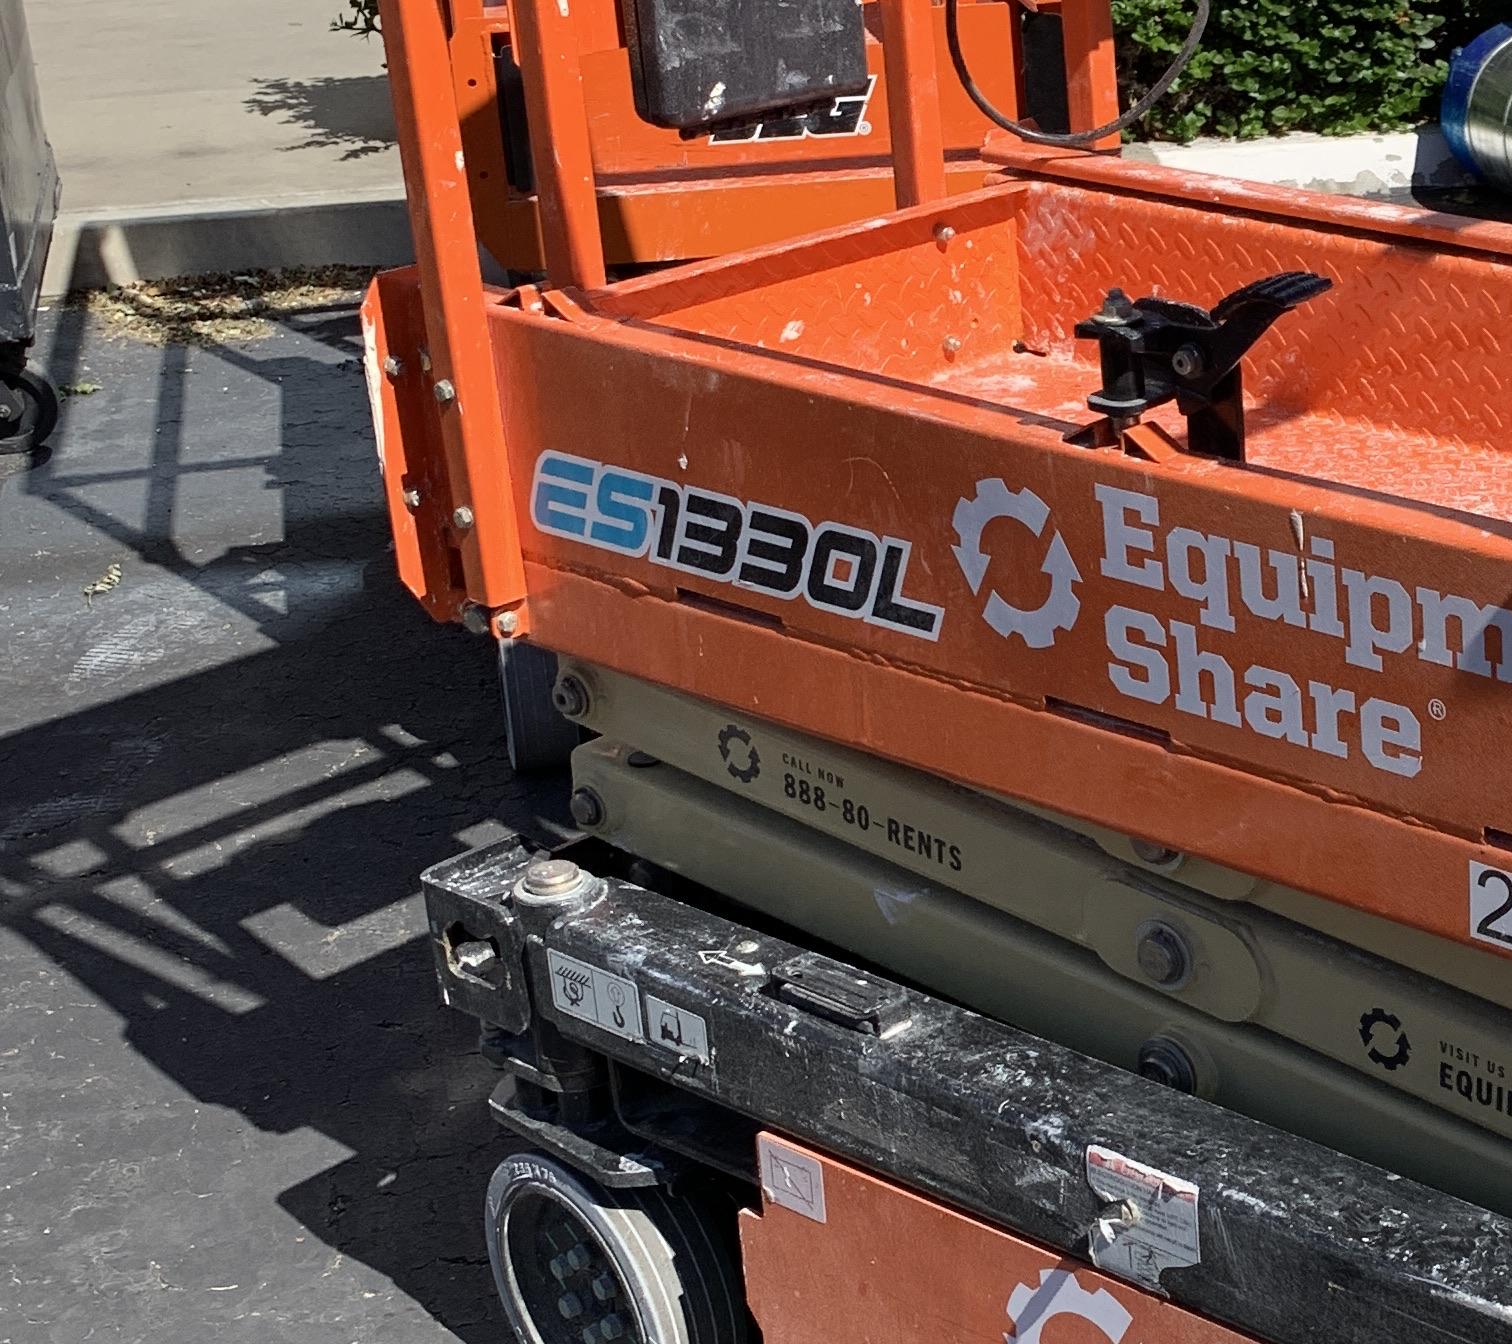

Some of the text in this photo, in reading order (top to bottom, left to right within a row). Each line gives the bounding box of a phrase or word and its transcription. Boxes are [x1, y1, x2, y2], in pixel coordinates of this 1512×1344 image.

[533, 451, 943, 640] ES1330L
[1104, 604, 1422, 778] Share
[782, 753, 845, 789] CALL NOW
[783, 774, 963, 873] 888-80-RENTS
[1439, 1040, 1481, 1069] VISIT
[1488, 1060, 1506, 1078] US
